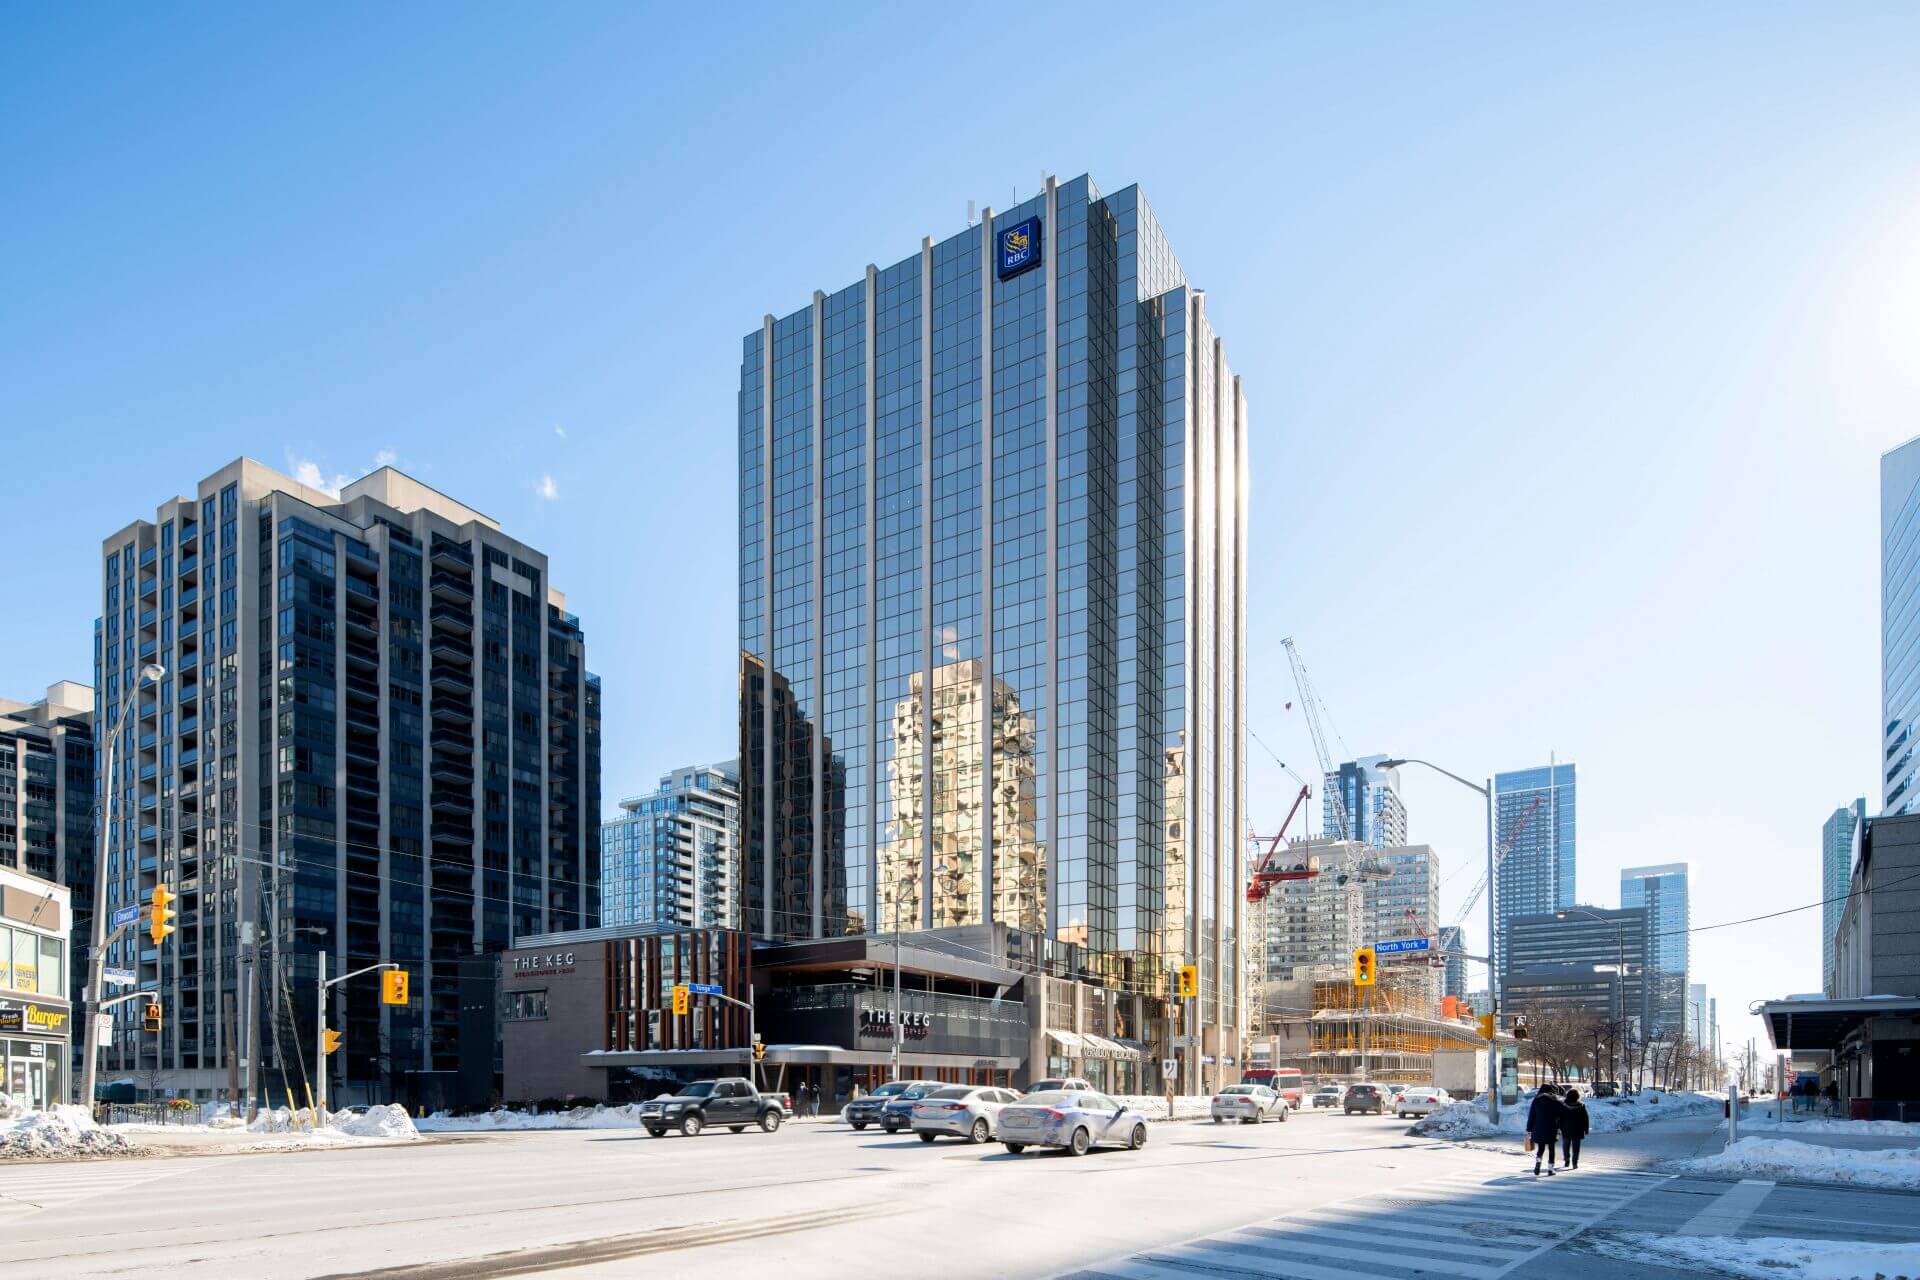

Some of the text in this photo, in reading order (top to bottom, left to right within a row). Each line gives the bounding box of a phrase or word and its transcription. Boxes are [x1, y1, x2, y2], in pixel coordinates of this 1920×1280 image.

[1007, 249, 1028, 265] RBC
[1376, 943, 1399, 952] North
[1401, 940, 1419, 950] York
[513, 952, 574, 969] THE KEG
[27, 1004, 68, 1031] Burger
[868, 1009, 930, 1027] THE KEG
